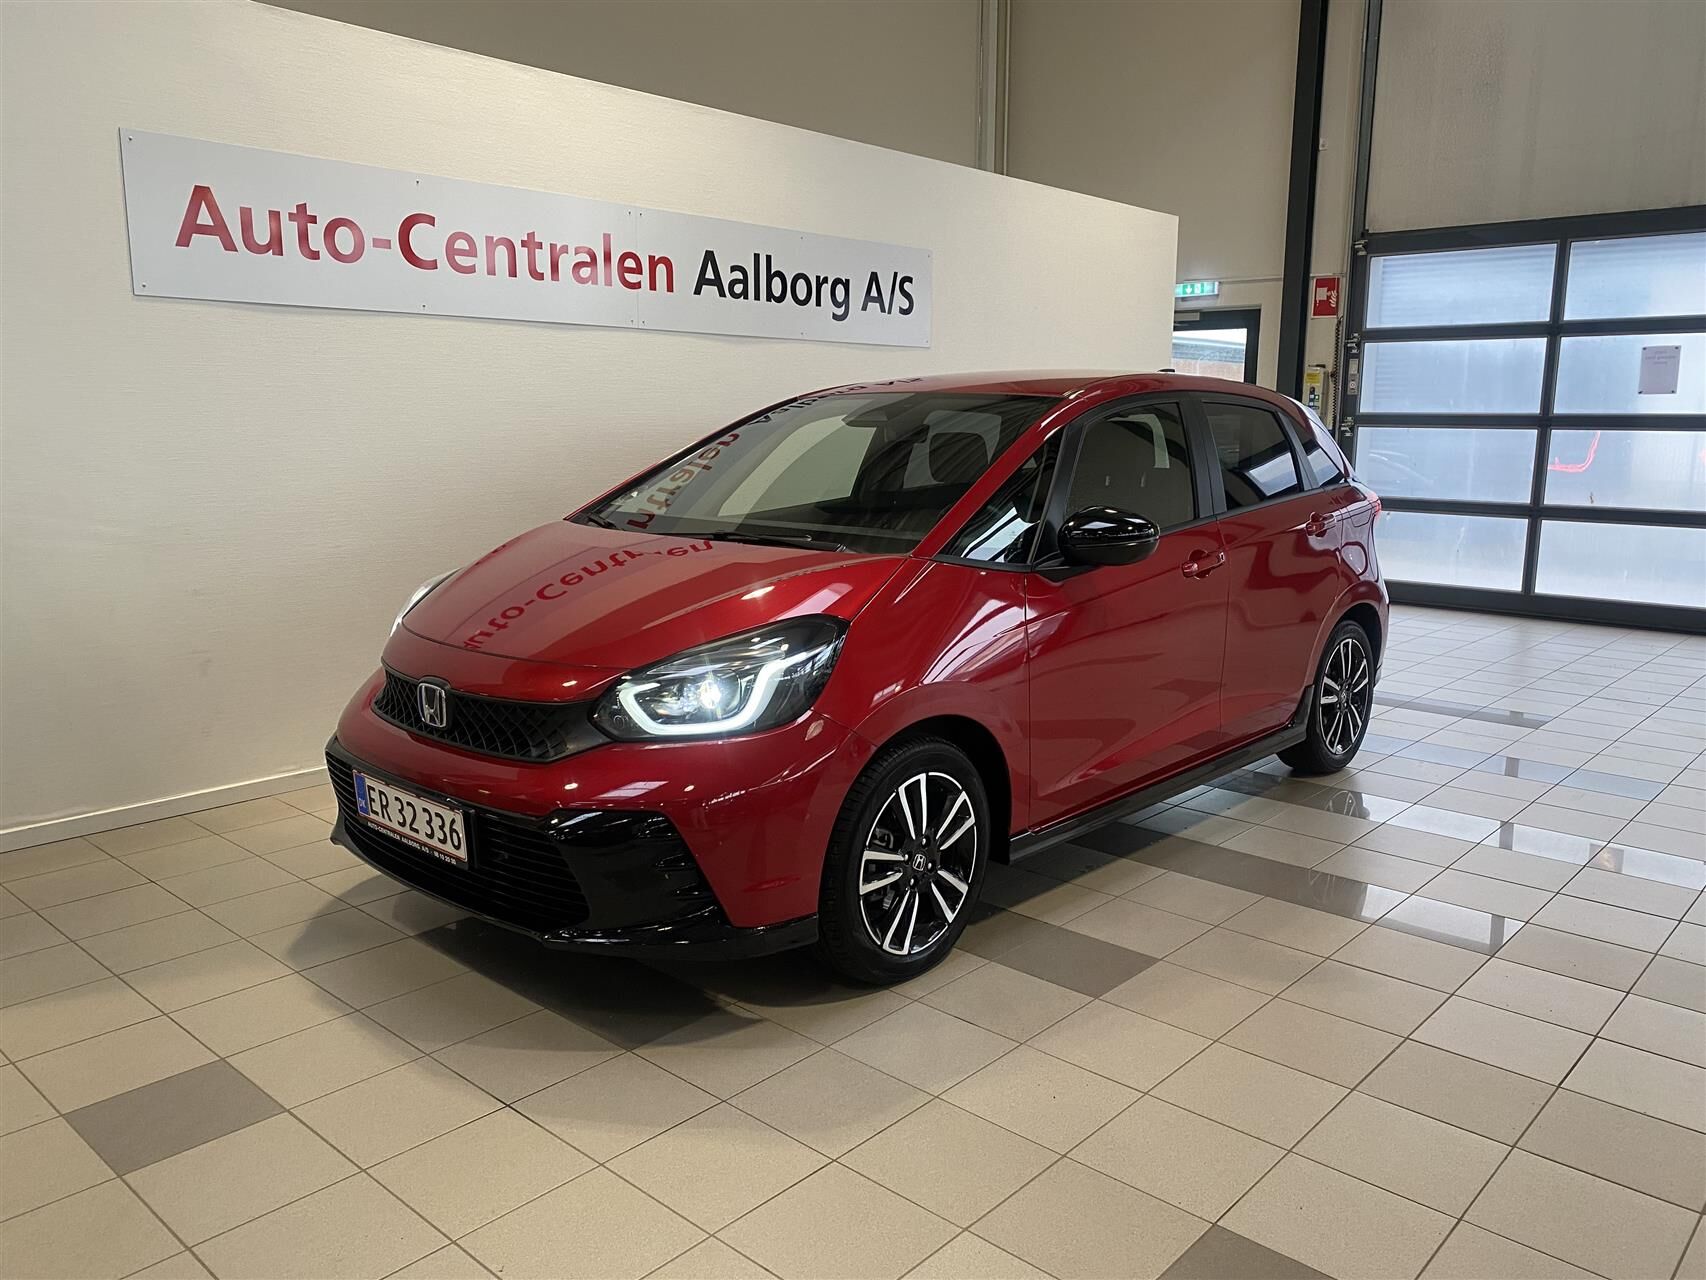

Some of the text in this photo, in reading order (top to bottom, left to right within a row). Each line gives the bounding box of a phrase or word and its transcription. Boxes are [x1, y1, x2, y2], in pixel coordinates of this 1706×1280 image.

[176, 185, 915, 322] Auto-Centralen Aalborg A/S
[367, 784, 462, 850] ER 32 336
